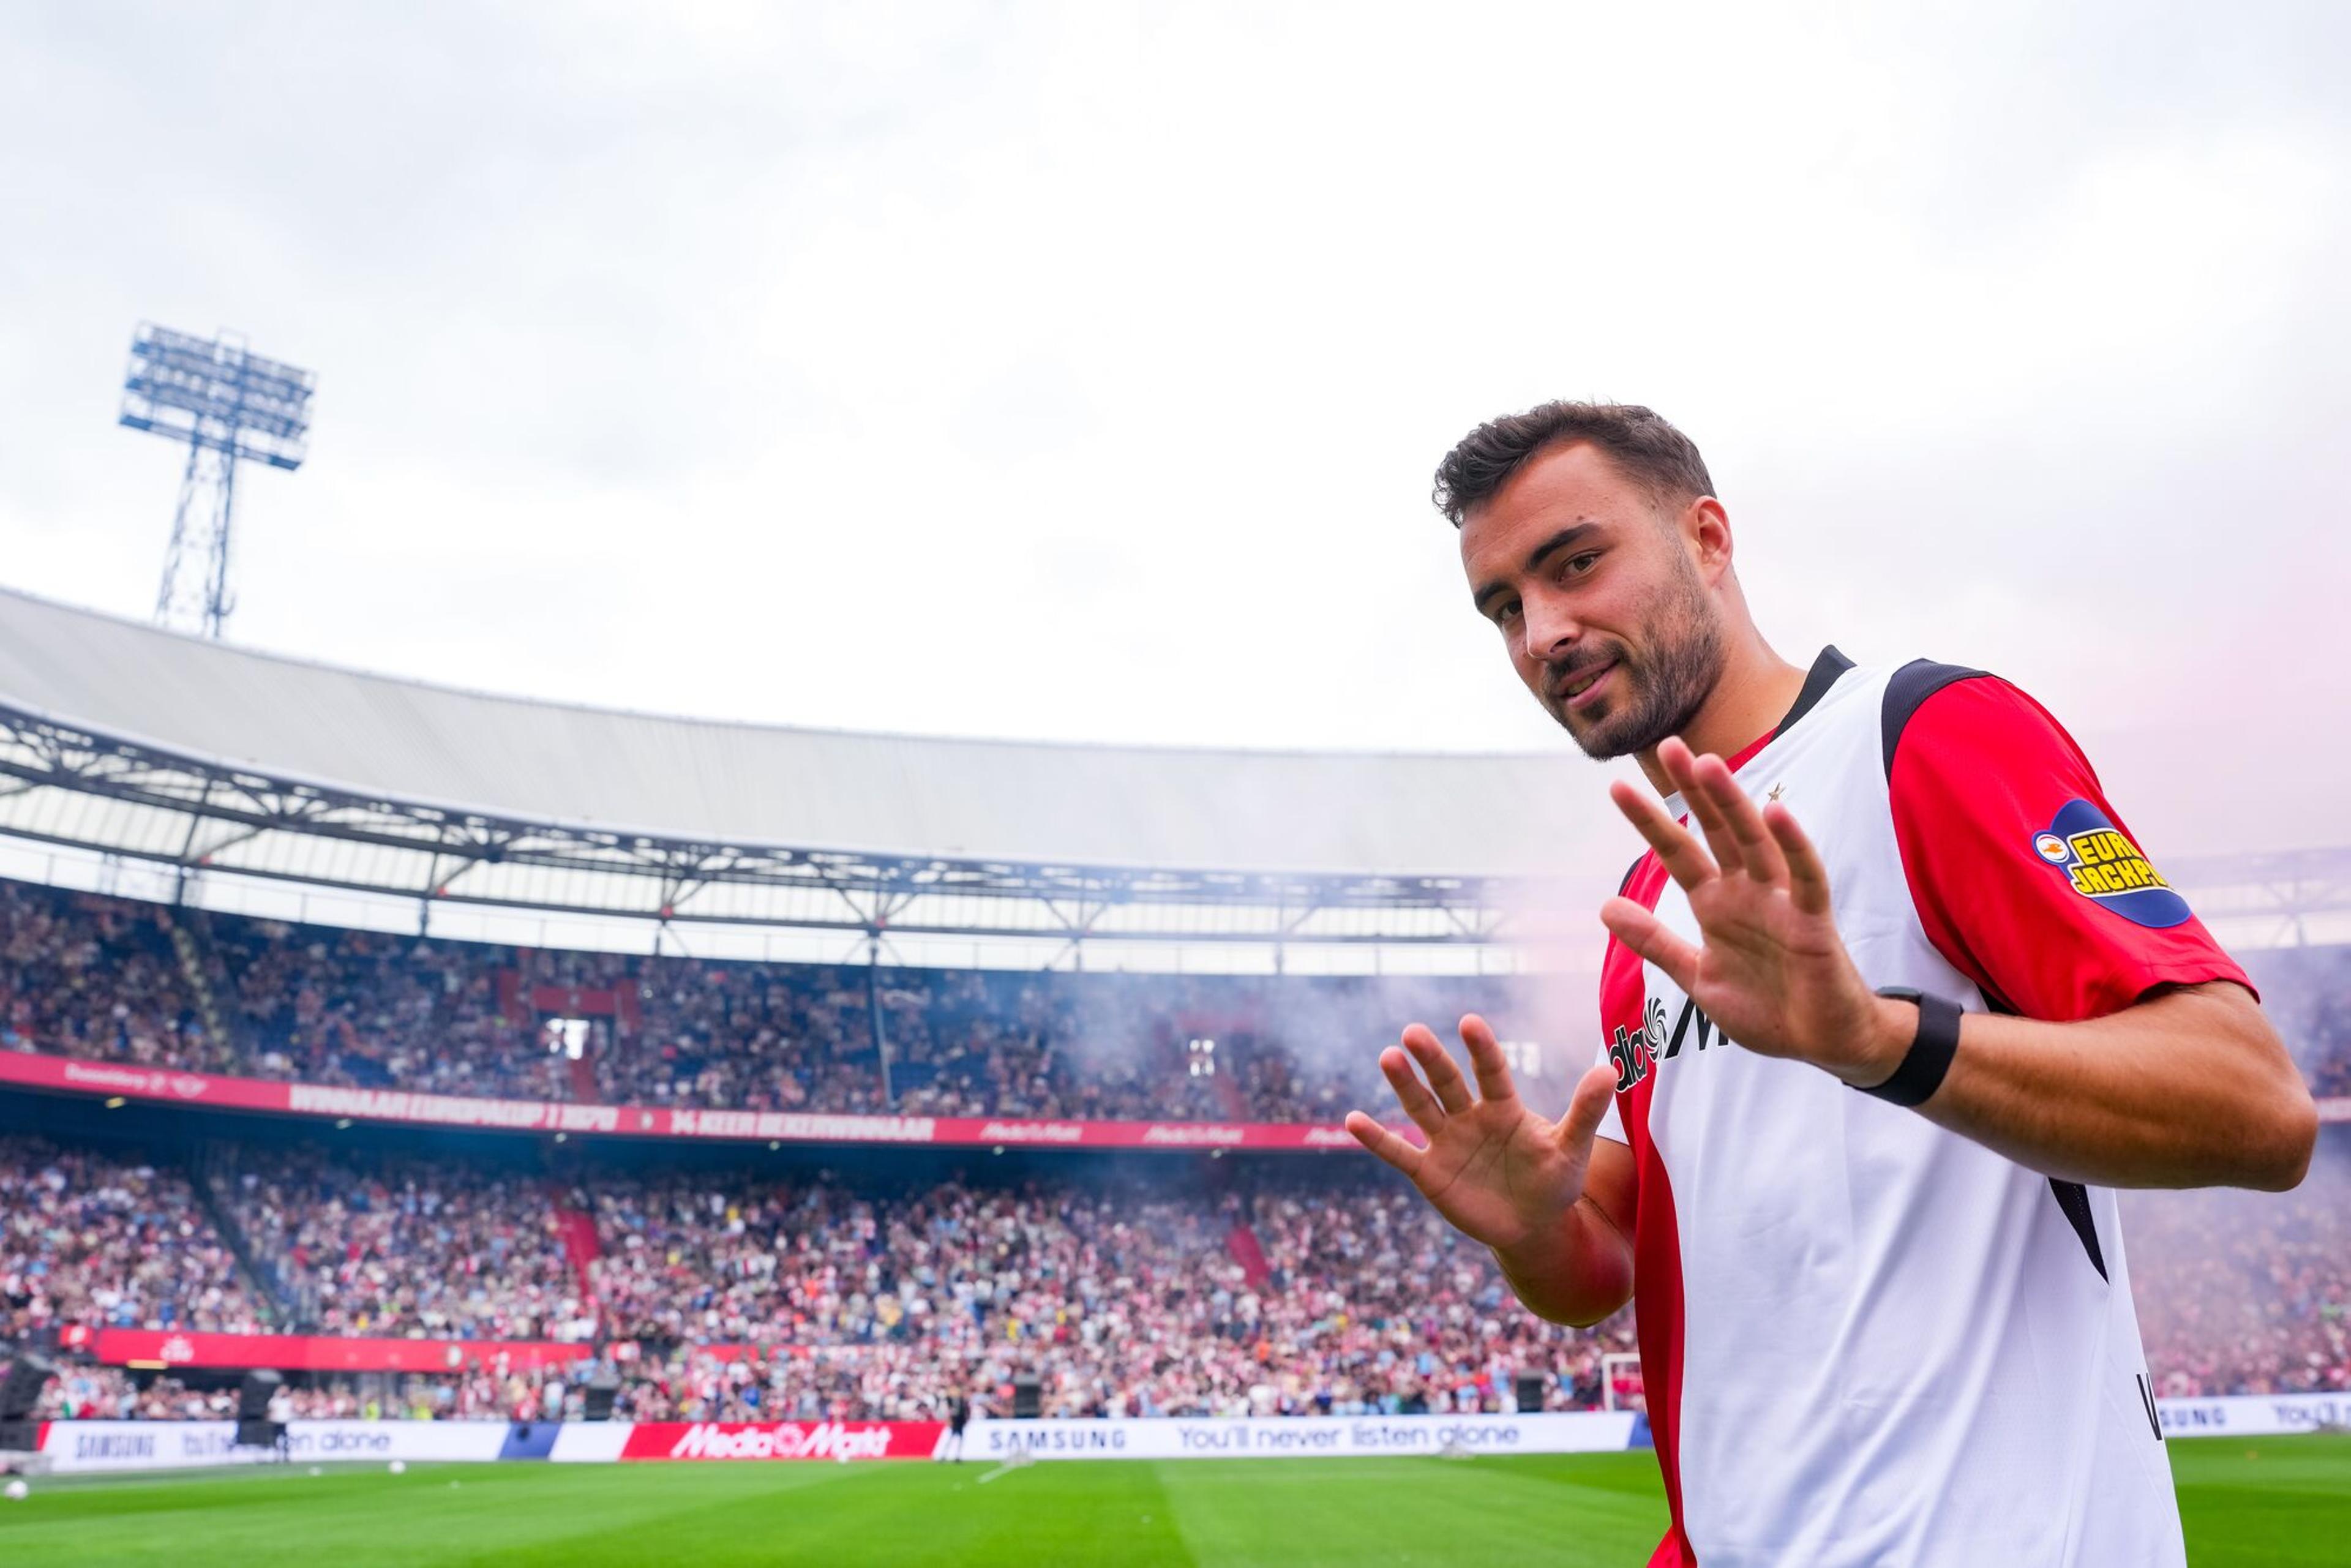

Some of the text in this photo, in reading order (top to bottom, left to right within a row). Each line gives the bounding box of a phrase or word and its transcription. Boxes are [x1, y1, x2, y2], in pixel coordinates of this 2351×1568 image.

[2071, 858, 2169, 893] JACKP
[989, 1428, 1126, 1450] SAMSUNG
[1178, 1423, 1520, 1450] You'll never listen alone
